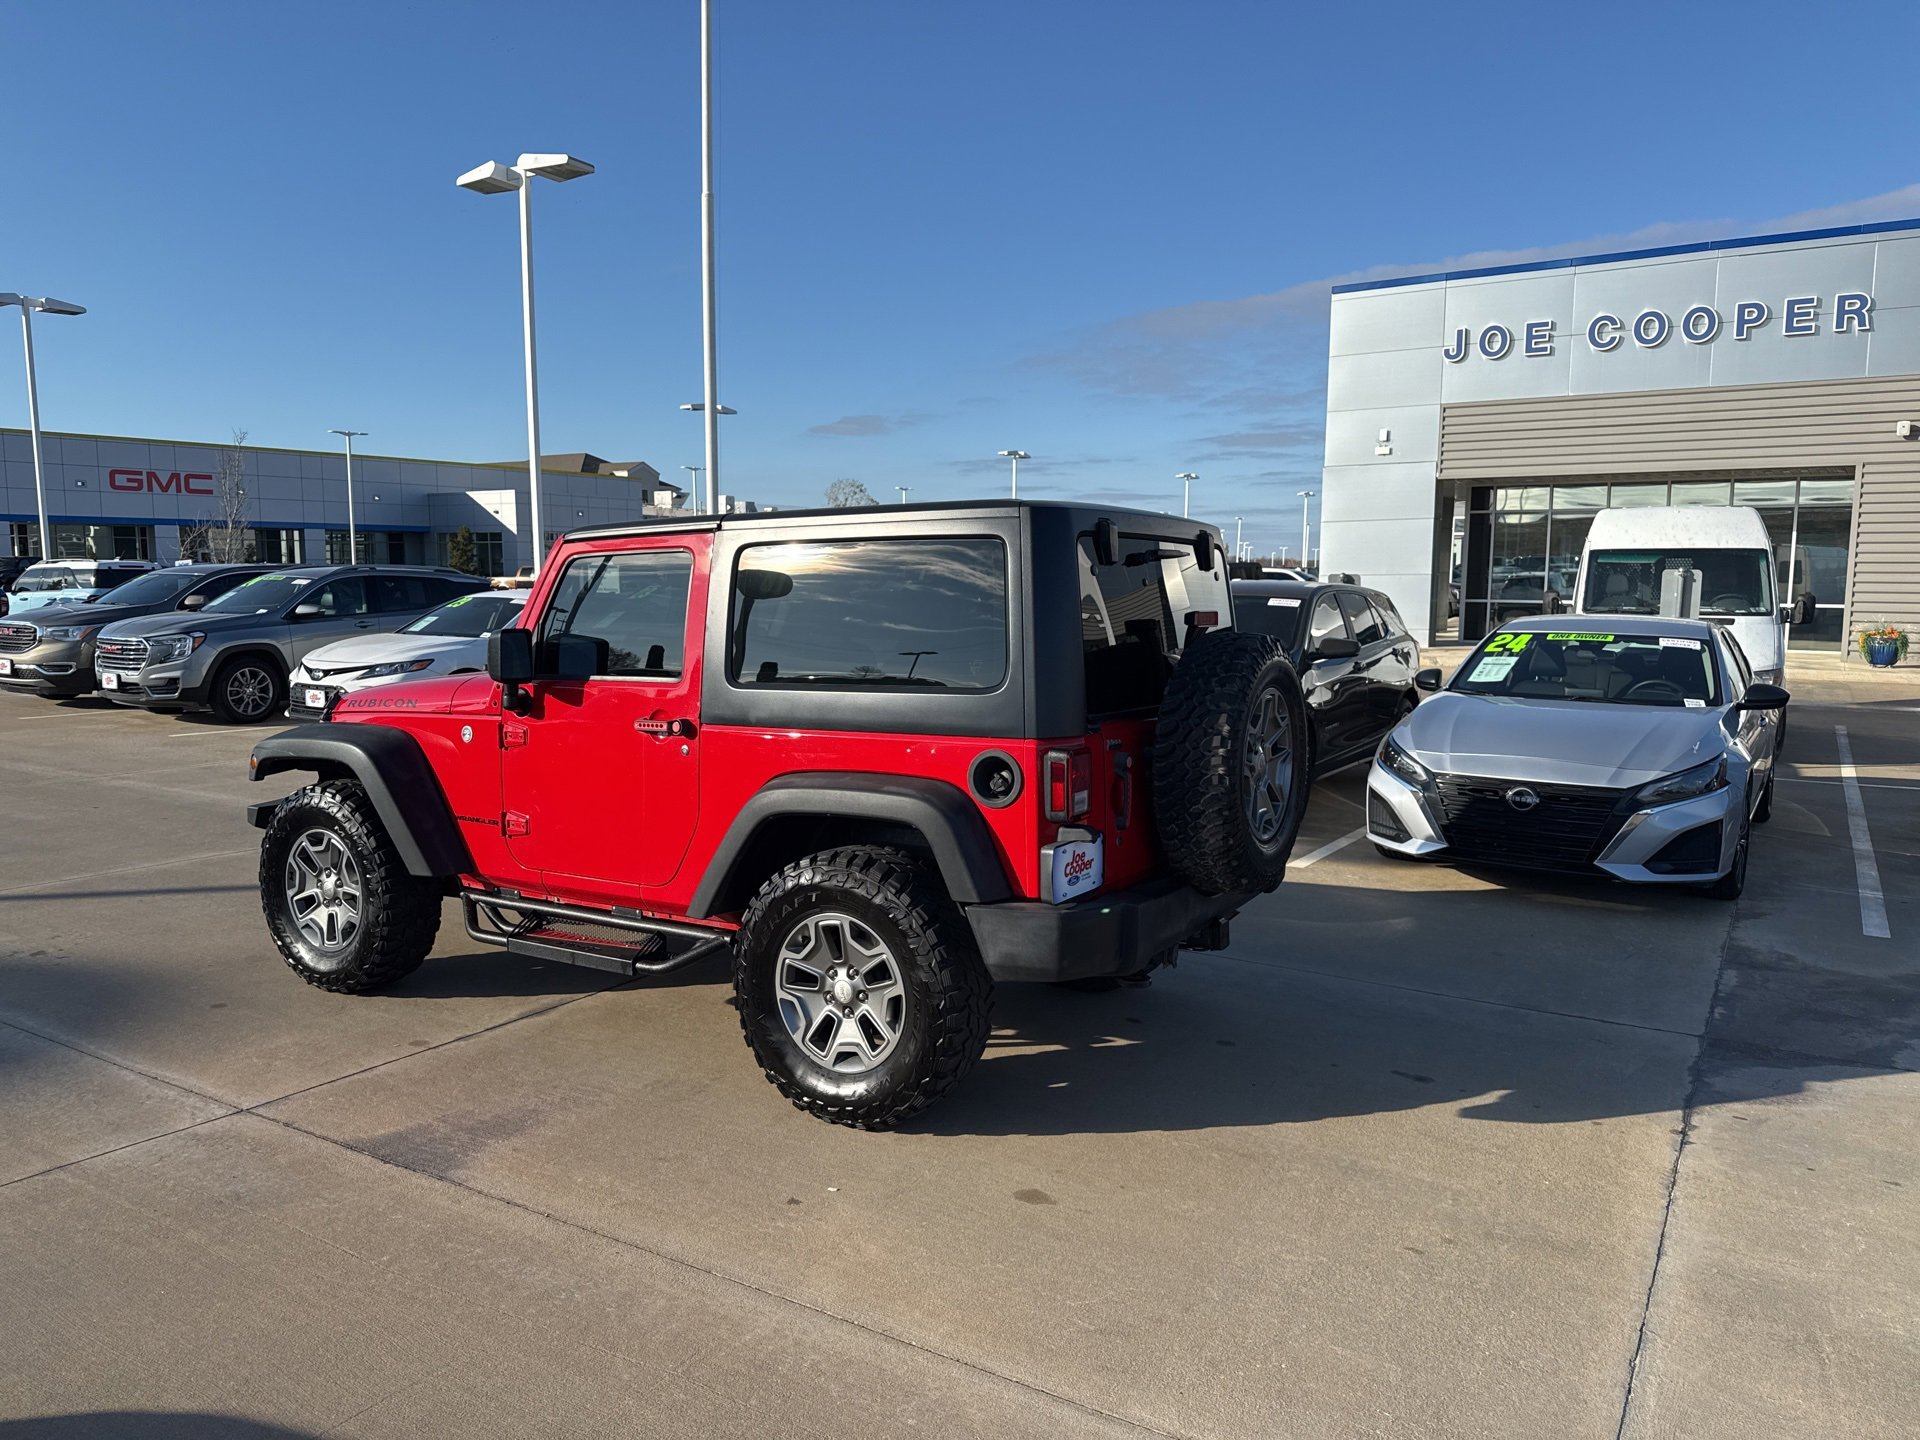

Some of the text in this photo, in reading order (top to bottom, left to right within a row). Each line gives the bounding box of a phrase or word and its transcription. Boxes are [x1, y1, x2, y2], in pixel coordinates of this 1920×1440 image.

[1443, 292, 1874, 362] JOE COOPER
[108, 469, 214, 495] GMC
[1484, 633, 1534, 653] 24
[347, 698, 419, 708] RUBICON
[1064, 857, 1095, 878] Cooper
[1071, 850, 1086, 866] Joe
